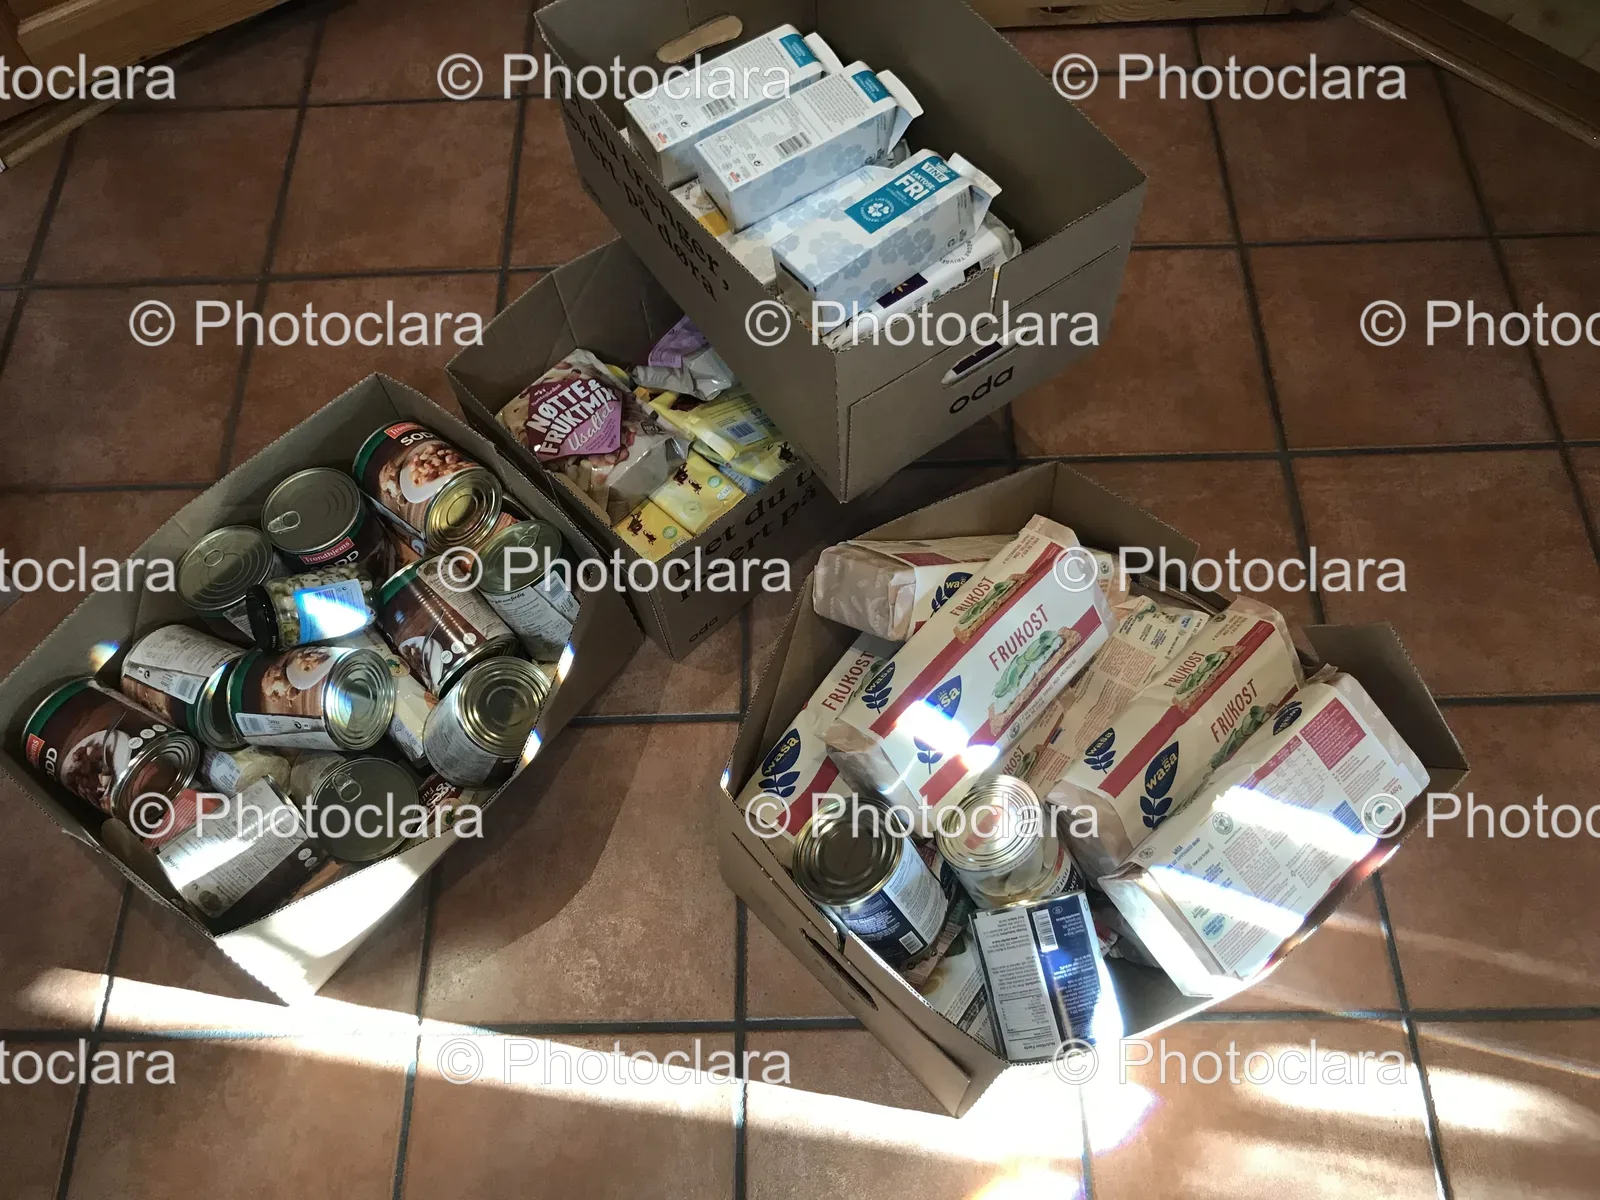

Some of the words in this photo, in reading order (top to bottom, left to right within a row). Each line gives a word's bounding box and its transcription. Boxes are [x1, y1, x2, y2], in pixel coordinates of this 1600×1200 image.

[894, 174, 930, 201] FRI
[926, 164, 945, 181] TINE
[657, 223, 717, 302] døra
[526, 379, 586, 434] NØTTE
[587, 379, 601, 391] &
[949, 366, 1014, 414] oda
[400, 430, 438, 446] SOD
[540, 386, 618, 454] FRUKTMIX
[567, 403, 616, 451] Usaltet
[745, 487, 787, 527] du
[781, 485, 818, 528] på
[304, 541, 351, 563] Trondhjems
[945, 575, 967, 588] was
[949, 577, 996, 617] FRUKOST
[688, 616, 719, 643] oda
[989, 604, 1050, 671] FRUKOST
[821, 650, 875, 711] FRUKOST
[867, 667, 895, 692] wasa
[1164, 650, 1205, 689] FRUKOST
[1210, 678, 1259, 744] FRUKOST
[764, 735, 799, 775] wasa
[1087, 731, 1114, 757] wasa
[1146, 751, 1179, 791] wasa
